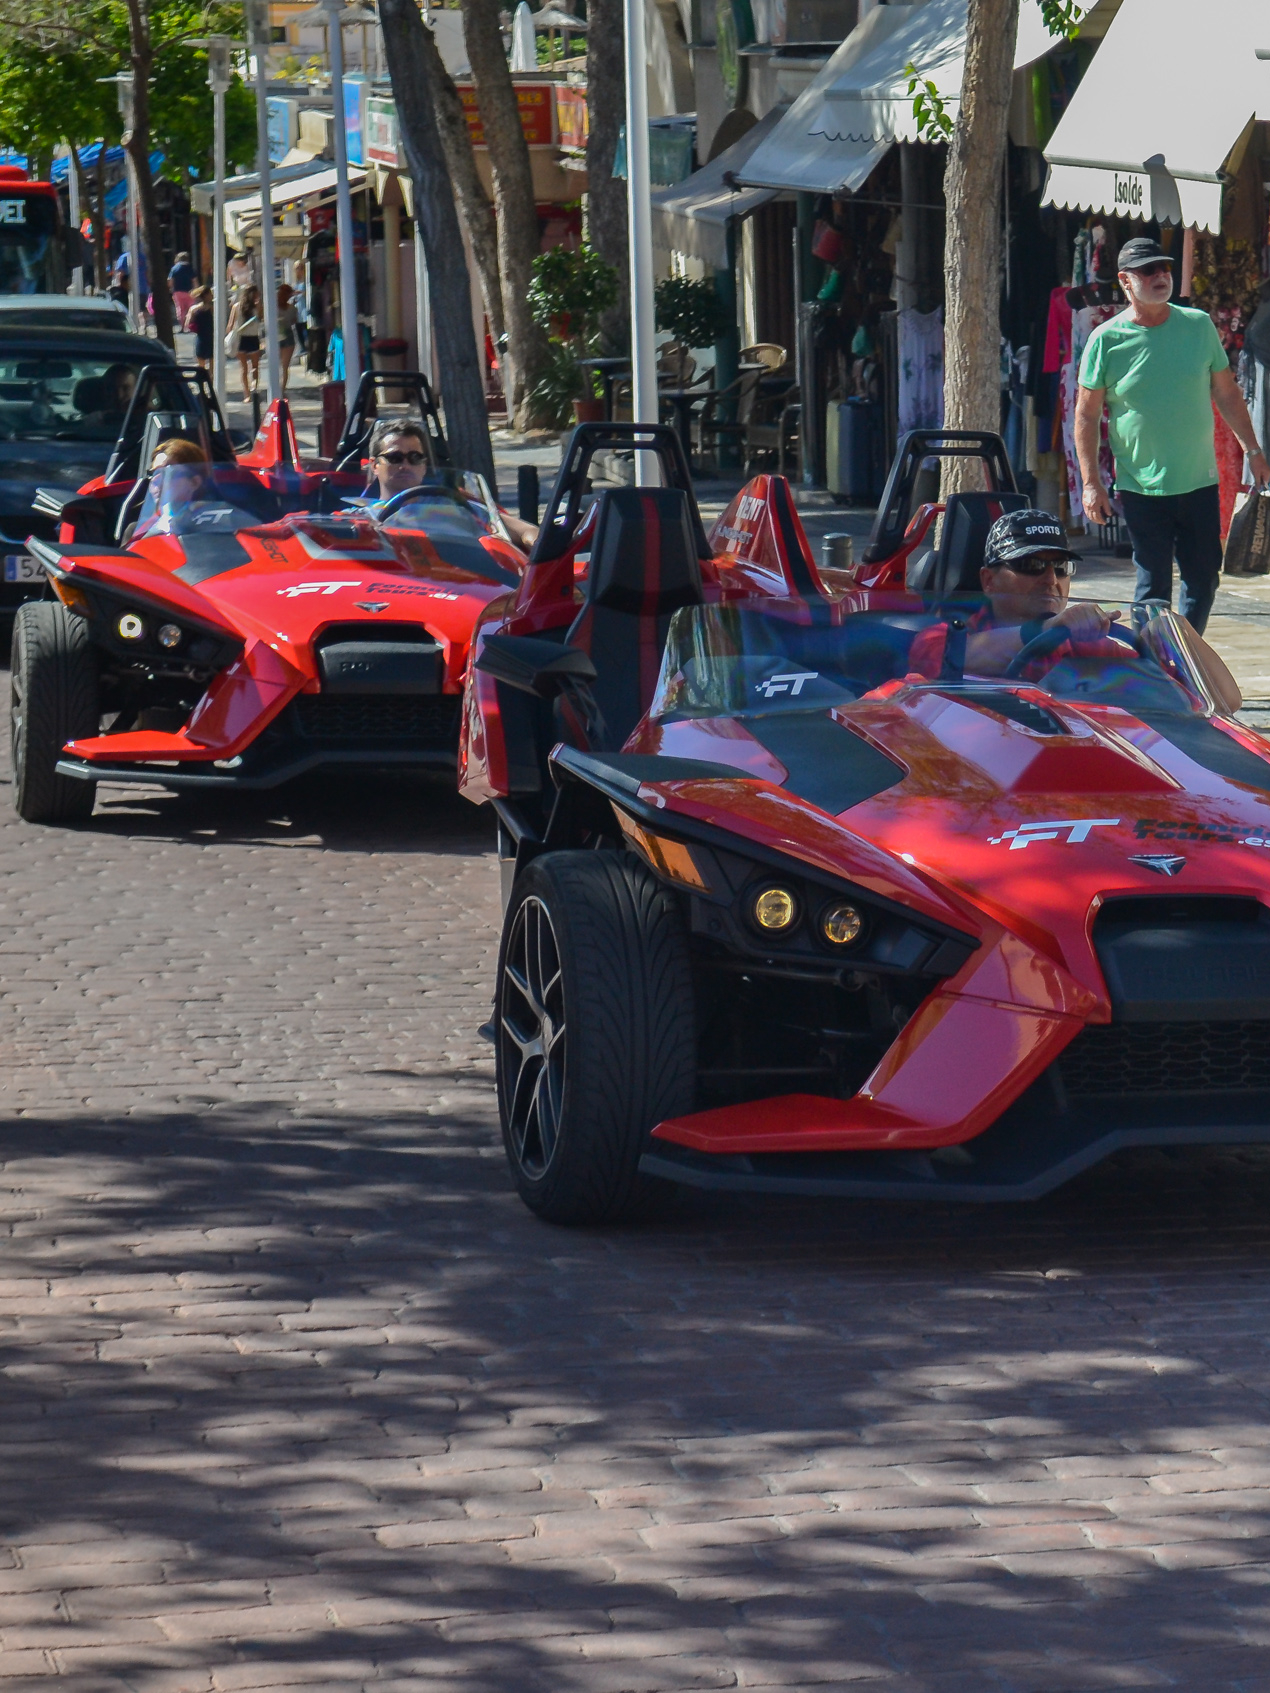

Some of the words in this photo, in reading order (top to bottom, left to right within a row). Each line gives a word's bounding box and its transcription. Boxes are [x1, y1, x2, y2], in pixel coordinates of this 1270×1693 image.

[1114, 172, 1143, 206] Isolde
[1025, 525, 1061, 536] SPORTS
[758, 672, 819, 698] FT
[996, 818, 1120, 850] FT
